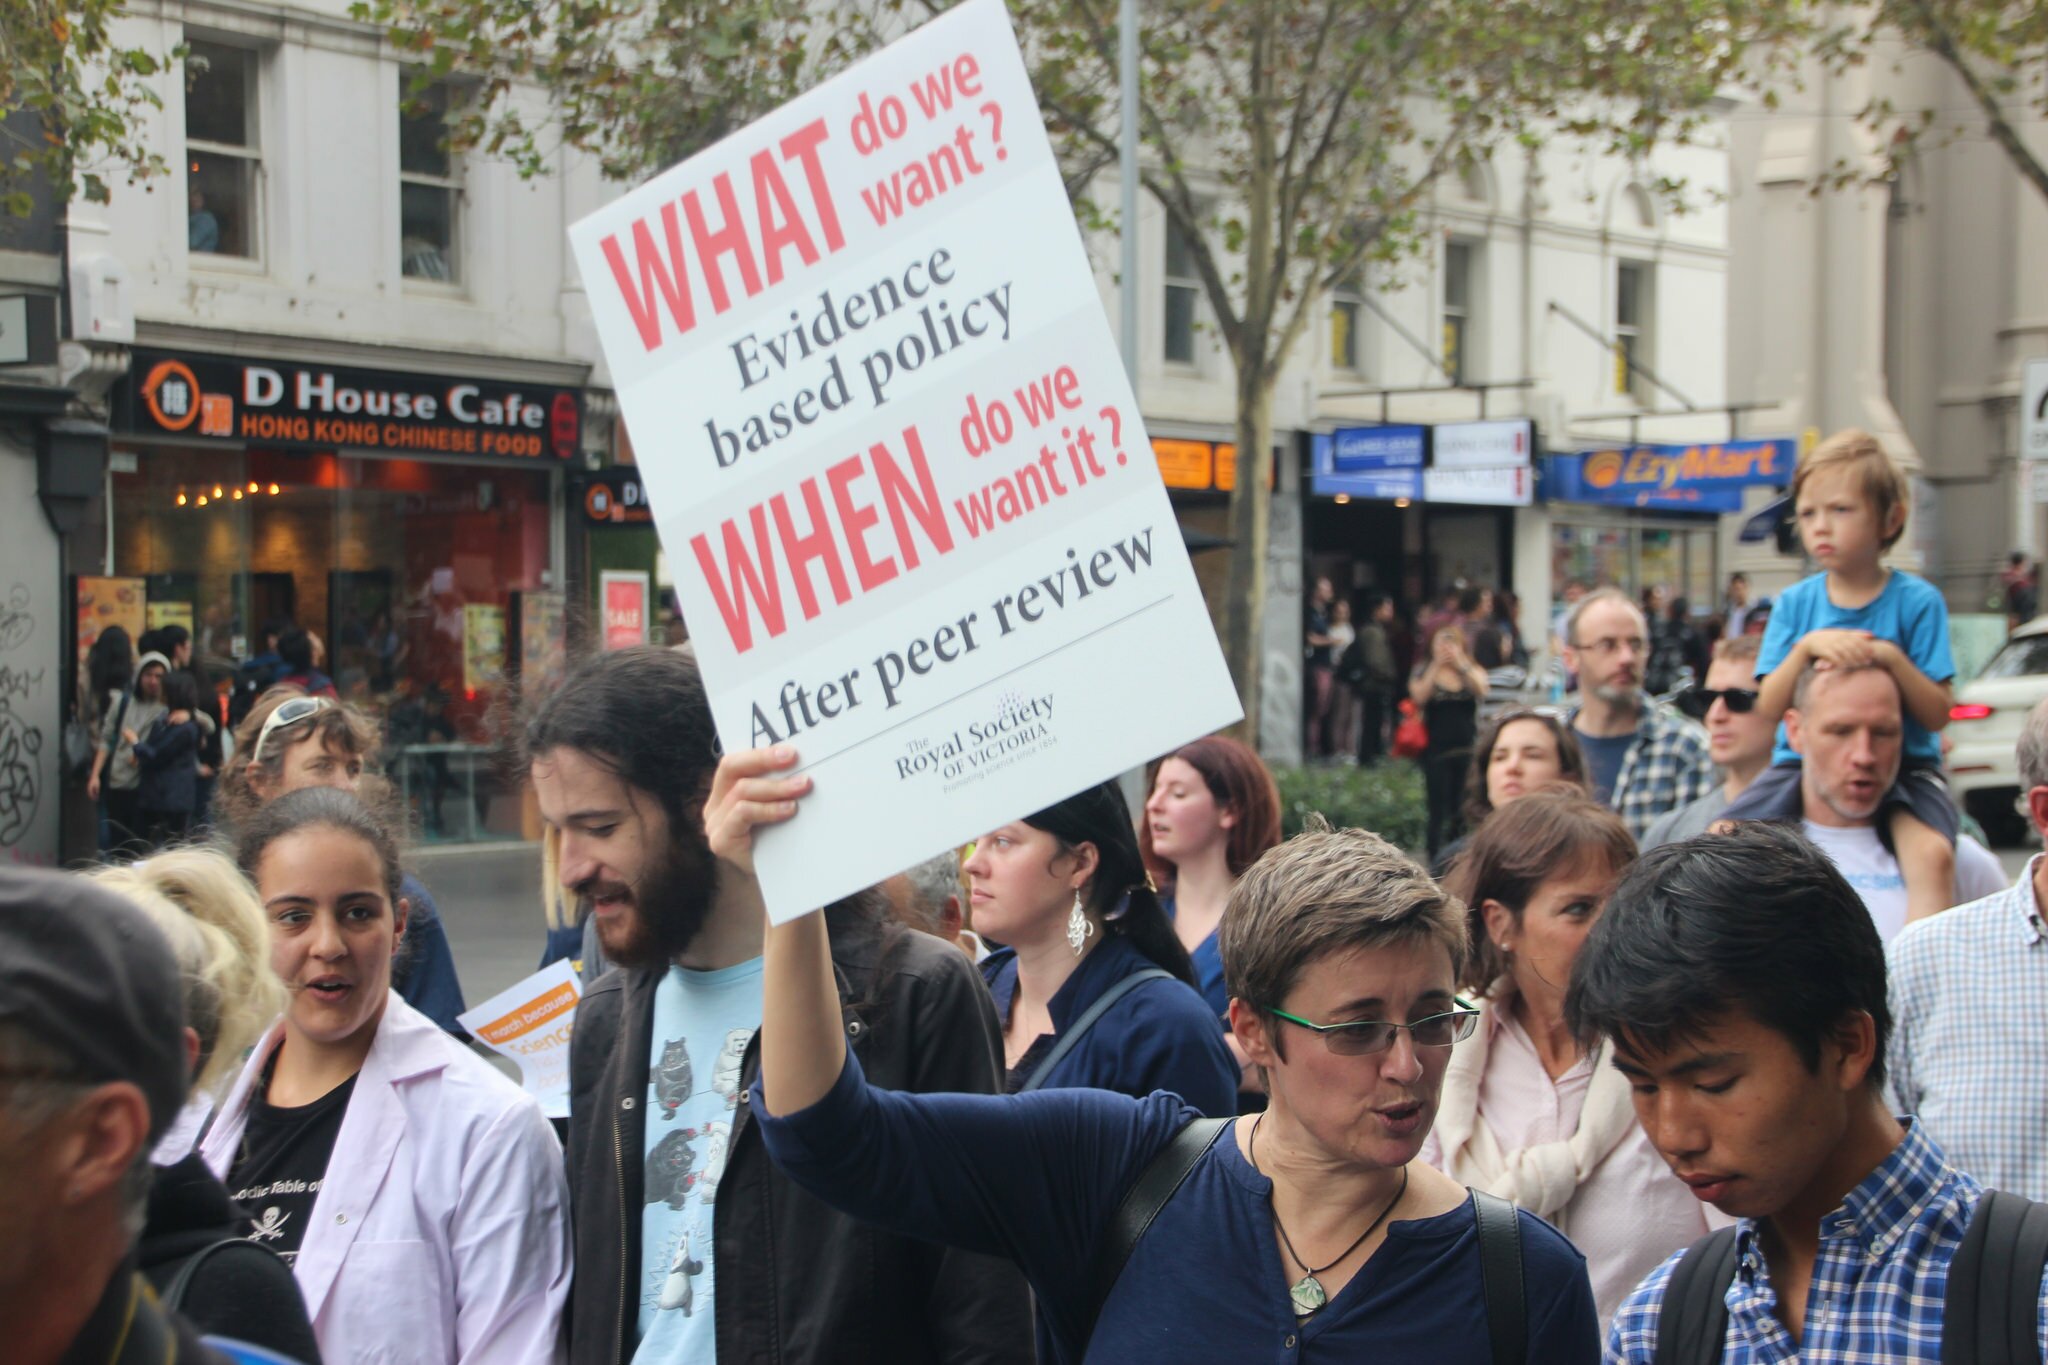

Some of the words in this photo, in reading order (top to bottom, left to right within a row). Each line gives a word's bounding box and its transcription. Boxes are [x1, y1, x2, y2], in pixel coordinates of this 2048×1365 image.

[850, 91, 908, 156] do
[910, 53, 983, 119] we
[600, 118, 845, 352] WHAT
[730, 247, 955, 391] Evidence
[244, 367, 284, 407] D
[295, 370, 438, 420] House
[446, 384, 544, 428] Cafe
[704, 354, 852, 468] based
[861, 282, 1013, 408] policy
[960, 394, 1014, 459] do
[1013, 365, 1083, 429] we
[241, 413, 310, 440] HONG
[314, 419, 379, 446] KONG
[383, 423, 476, 453] CHINESE
[481, 431, 541, 457] FOOD
[953, 446, 1069, 540] want
[690, 426, 954, 655] WHEN
[608, 608, 640, 627] SALE
[750, 668, 861, 749] After
[872, 612, 979, 709] peer
[992, 527, 1154, 636] review
[895, 731, 963, 780] Royal
[969, 693, 1054, 746] Society
[906, 736, 930, 754] The
[943, 758, 965, 780] OF
[968, 722, 1048, 768] VICTORIA
[491, 1018, 524, 1040] march
[521, 991, 573, 1025] because
[270, 1178, 308, 1195] Table
